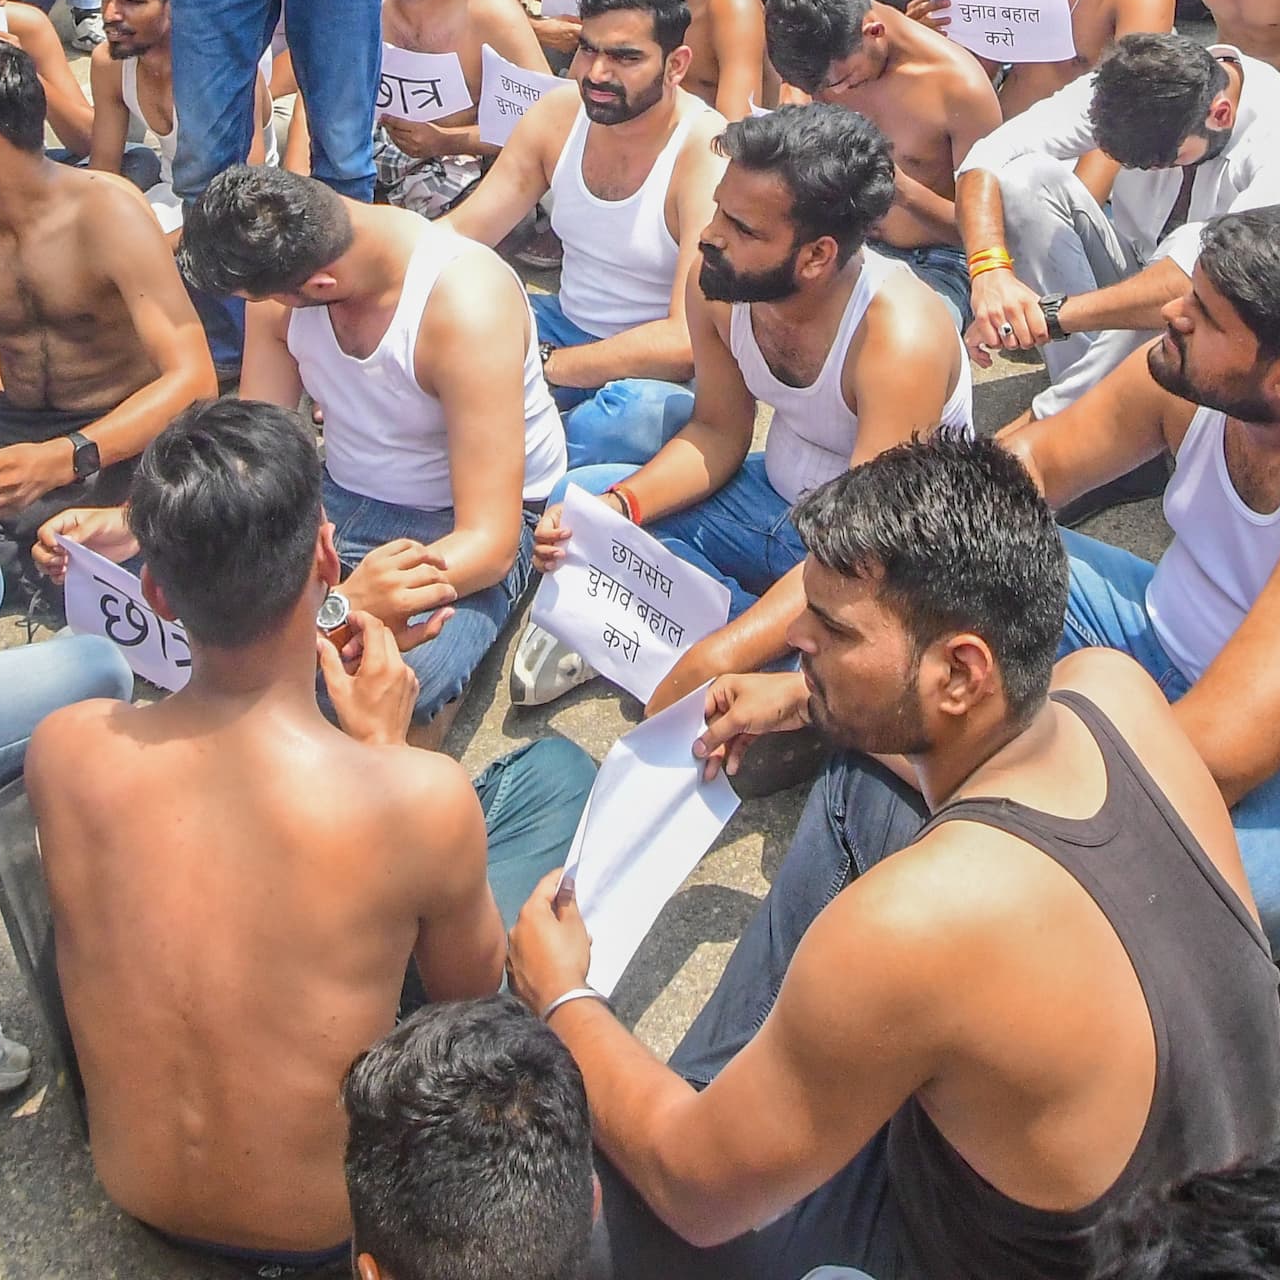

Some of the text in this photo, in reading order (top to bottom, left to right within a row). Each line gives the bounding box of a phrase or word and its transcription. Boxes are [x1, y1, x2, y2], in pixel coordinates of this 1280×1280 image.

[958, 3, 1040, 23] चुनाव बहाल
[984, 27, 1015, 47] करो
[499, 74, 541, 102] छात्रसंघ
[495, 94, 524, 116] चुनाव
[611, 538, 674, 599] छात्रसंघ
[587, 563, 686, 648] चुनाव बहाल
[603, 622, 641, 663] करो
